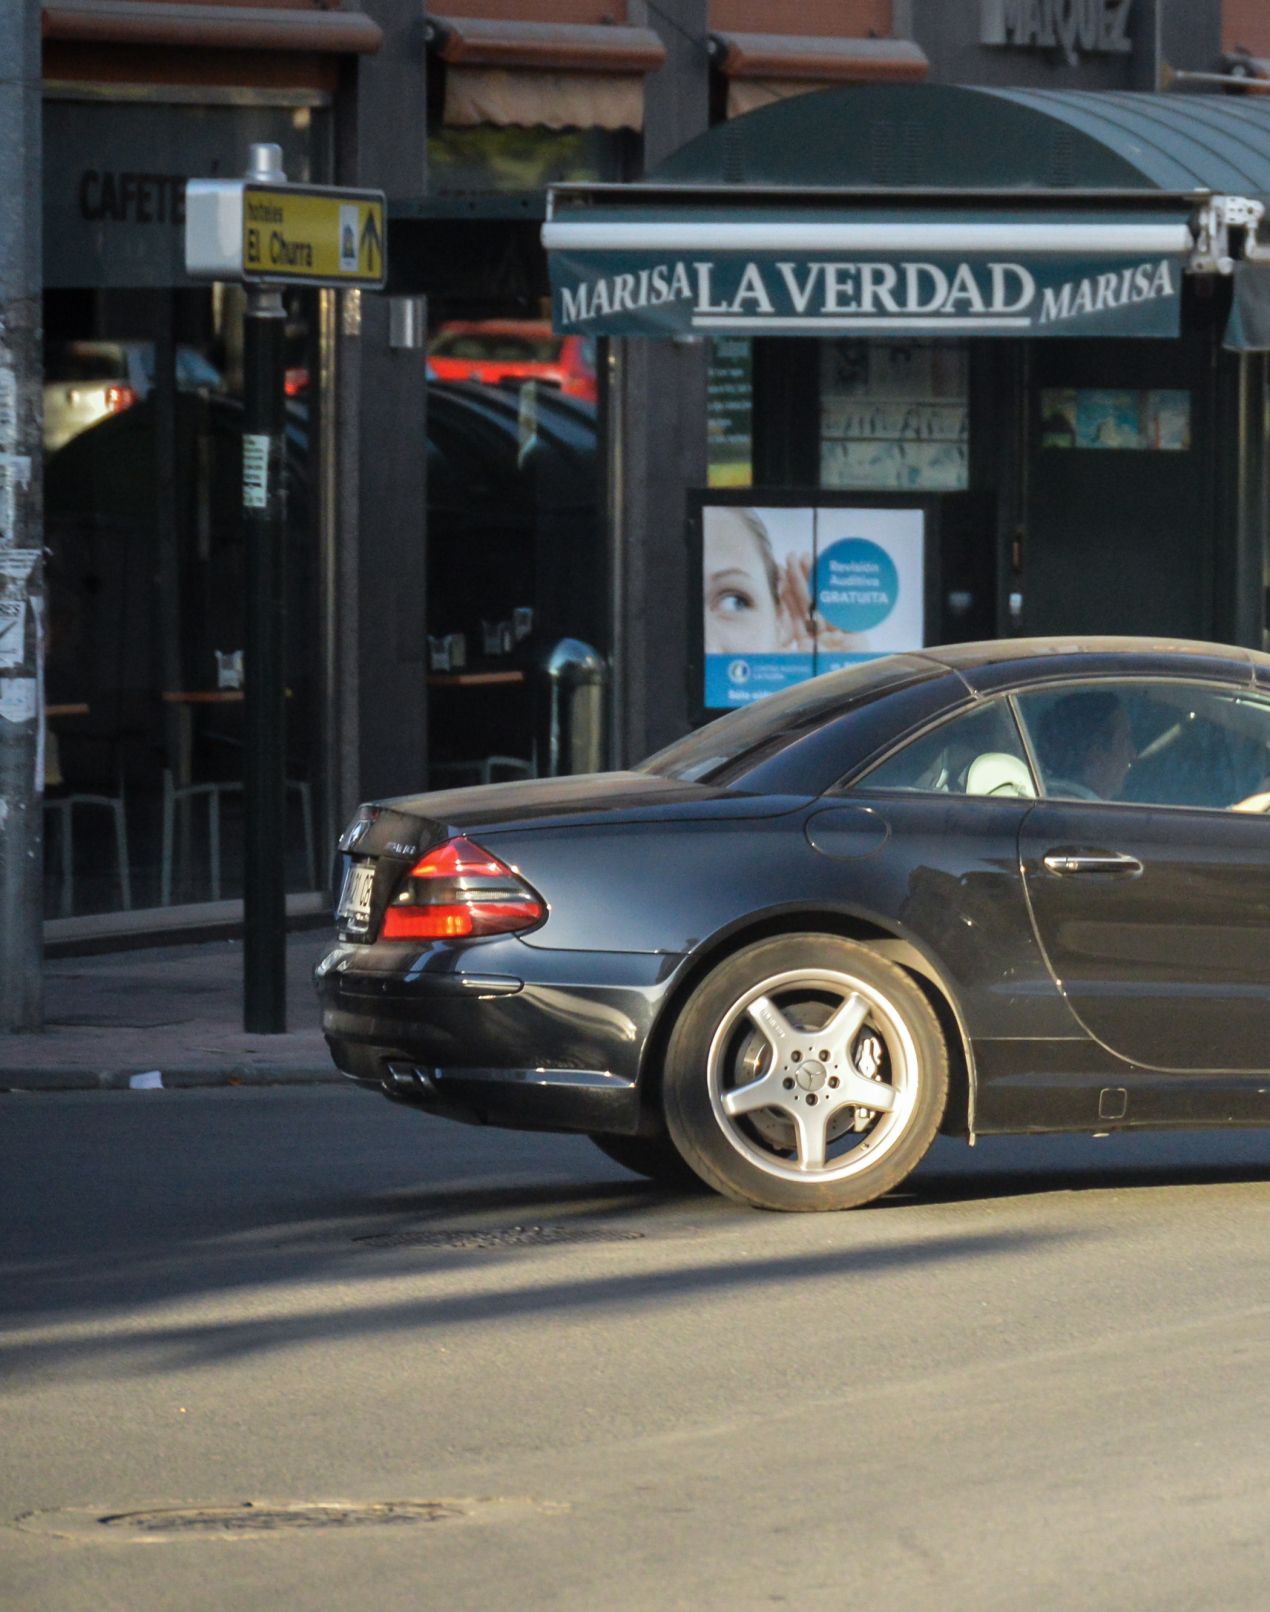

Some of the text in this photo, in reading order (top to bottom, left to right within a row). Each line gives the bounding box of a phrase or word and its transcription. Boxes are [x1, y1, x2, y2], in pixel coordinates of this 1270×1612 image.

[80, 169, 187, 226] CAFETE
[247, 228, 313, 267] El Churra
[560, 260, 1175, 325] MARISA LA VERDAD MARISA
[819, 590, 889, 604] GRATUITA
